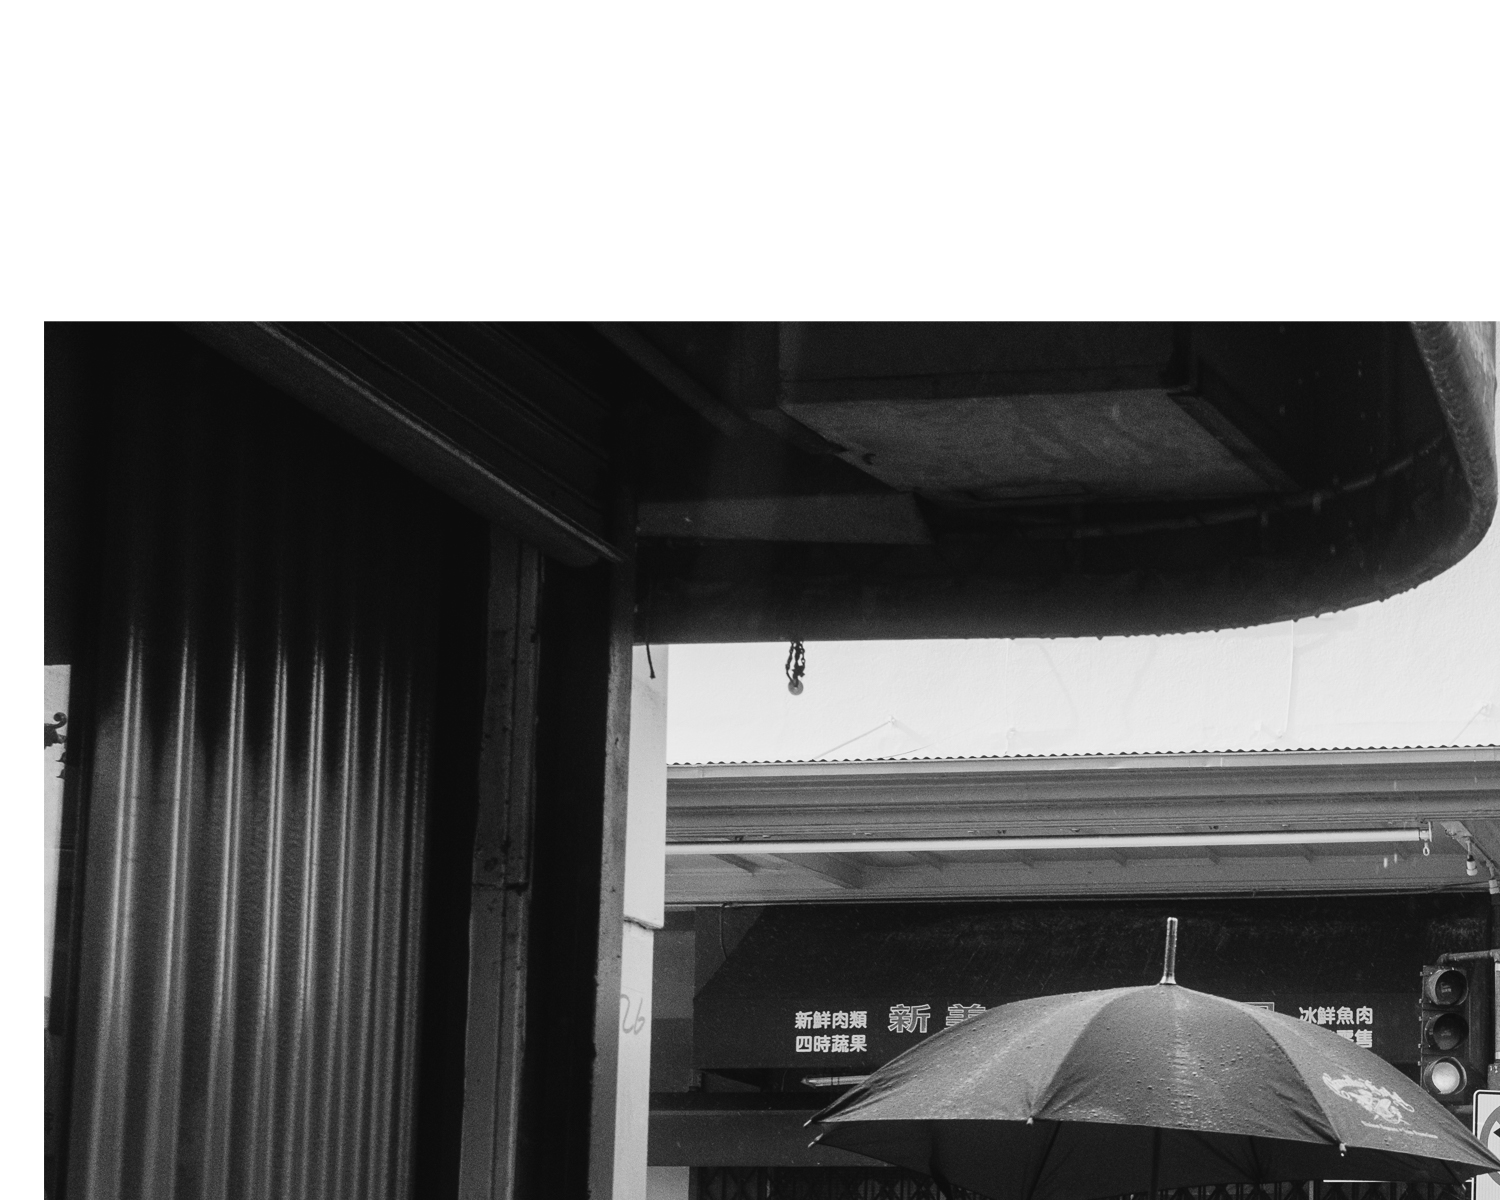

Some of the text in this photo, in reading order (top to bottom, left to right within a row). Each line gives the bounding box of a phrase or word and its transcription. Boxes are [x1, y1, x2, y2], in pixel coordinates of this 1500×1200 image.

[794, 1011, 868, 1030] 新鮮肉類
[1298, 1006, 1374, 1025] 冰鮮魚肉
[795, 1034, 868, 1053] 四時蔬果
